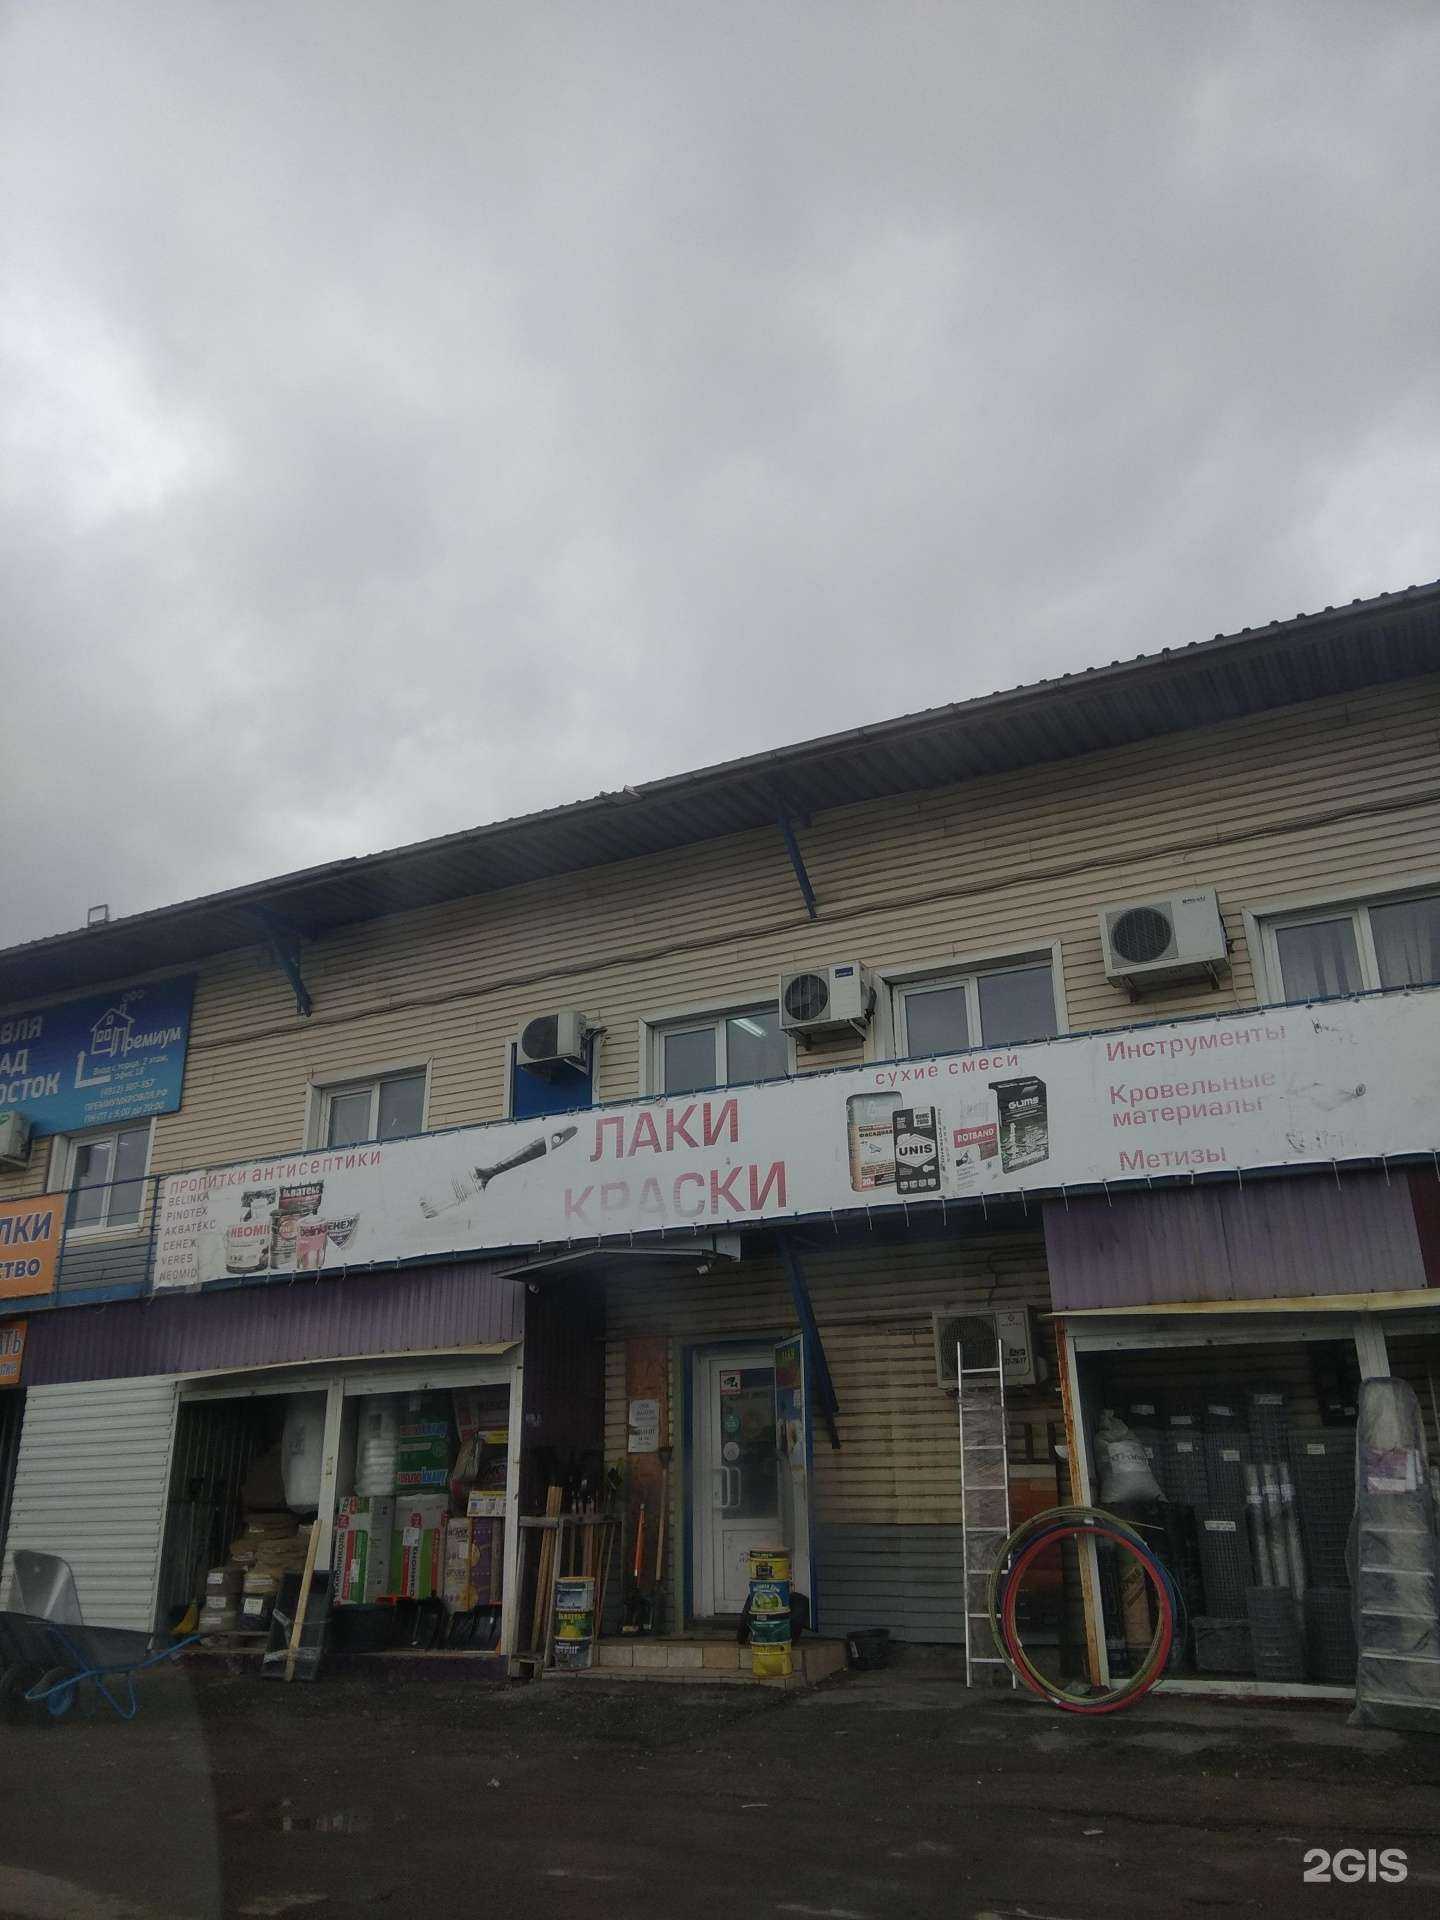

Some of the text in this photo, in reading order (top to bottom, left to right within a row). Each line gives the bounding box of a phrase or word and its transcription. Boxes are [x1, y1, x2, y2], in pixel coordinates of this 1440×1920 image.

[1106, 1026, 1287, 1061] Инструменты
[875, 1054, 1018, 1087] сухие смеси
[1109, 1072, 1276, 1108] Кровельные
[1113, 1096, 1264, 1128] материалы
[589, 1098, 738, 1162] ЛАКИ
[899, 1143, 933, 1156] UNIS
[1119, 1146, 1228, 1171] Метизы
[169, 1150, 382, 1195] ПРОПИТКИ антисептики
[564, 1161, 788, 1221] КРАСКИ
[166, 1207, 209, 1222] PINOTEX
